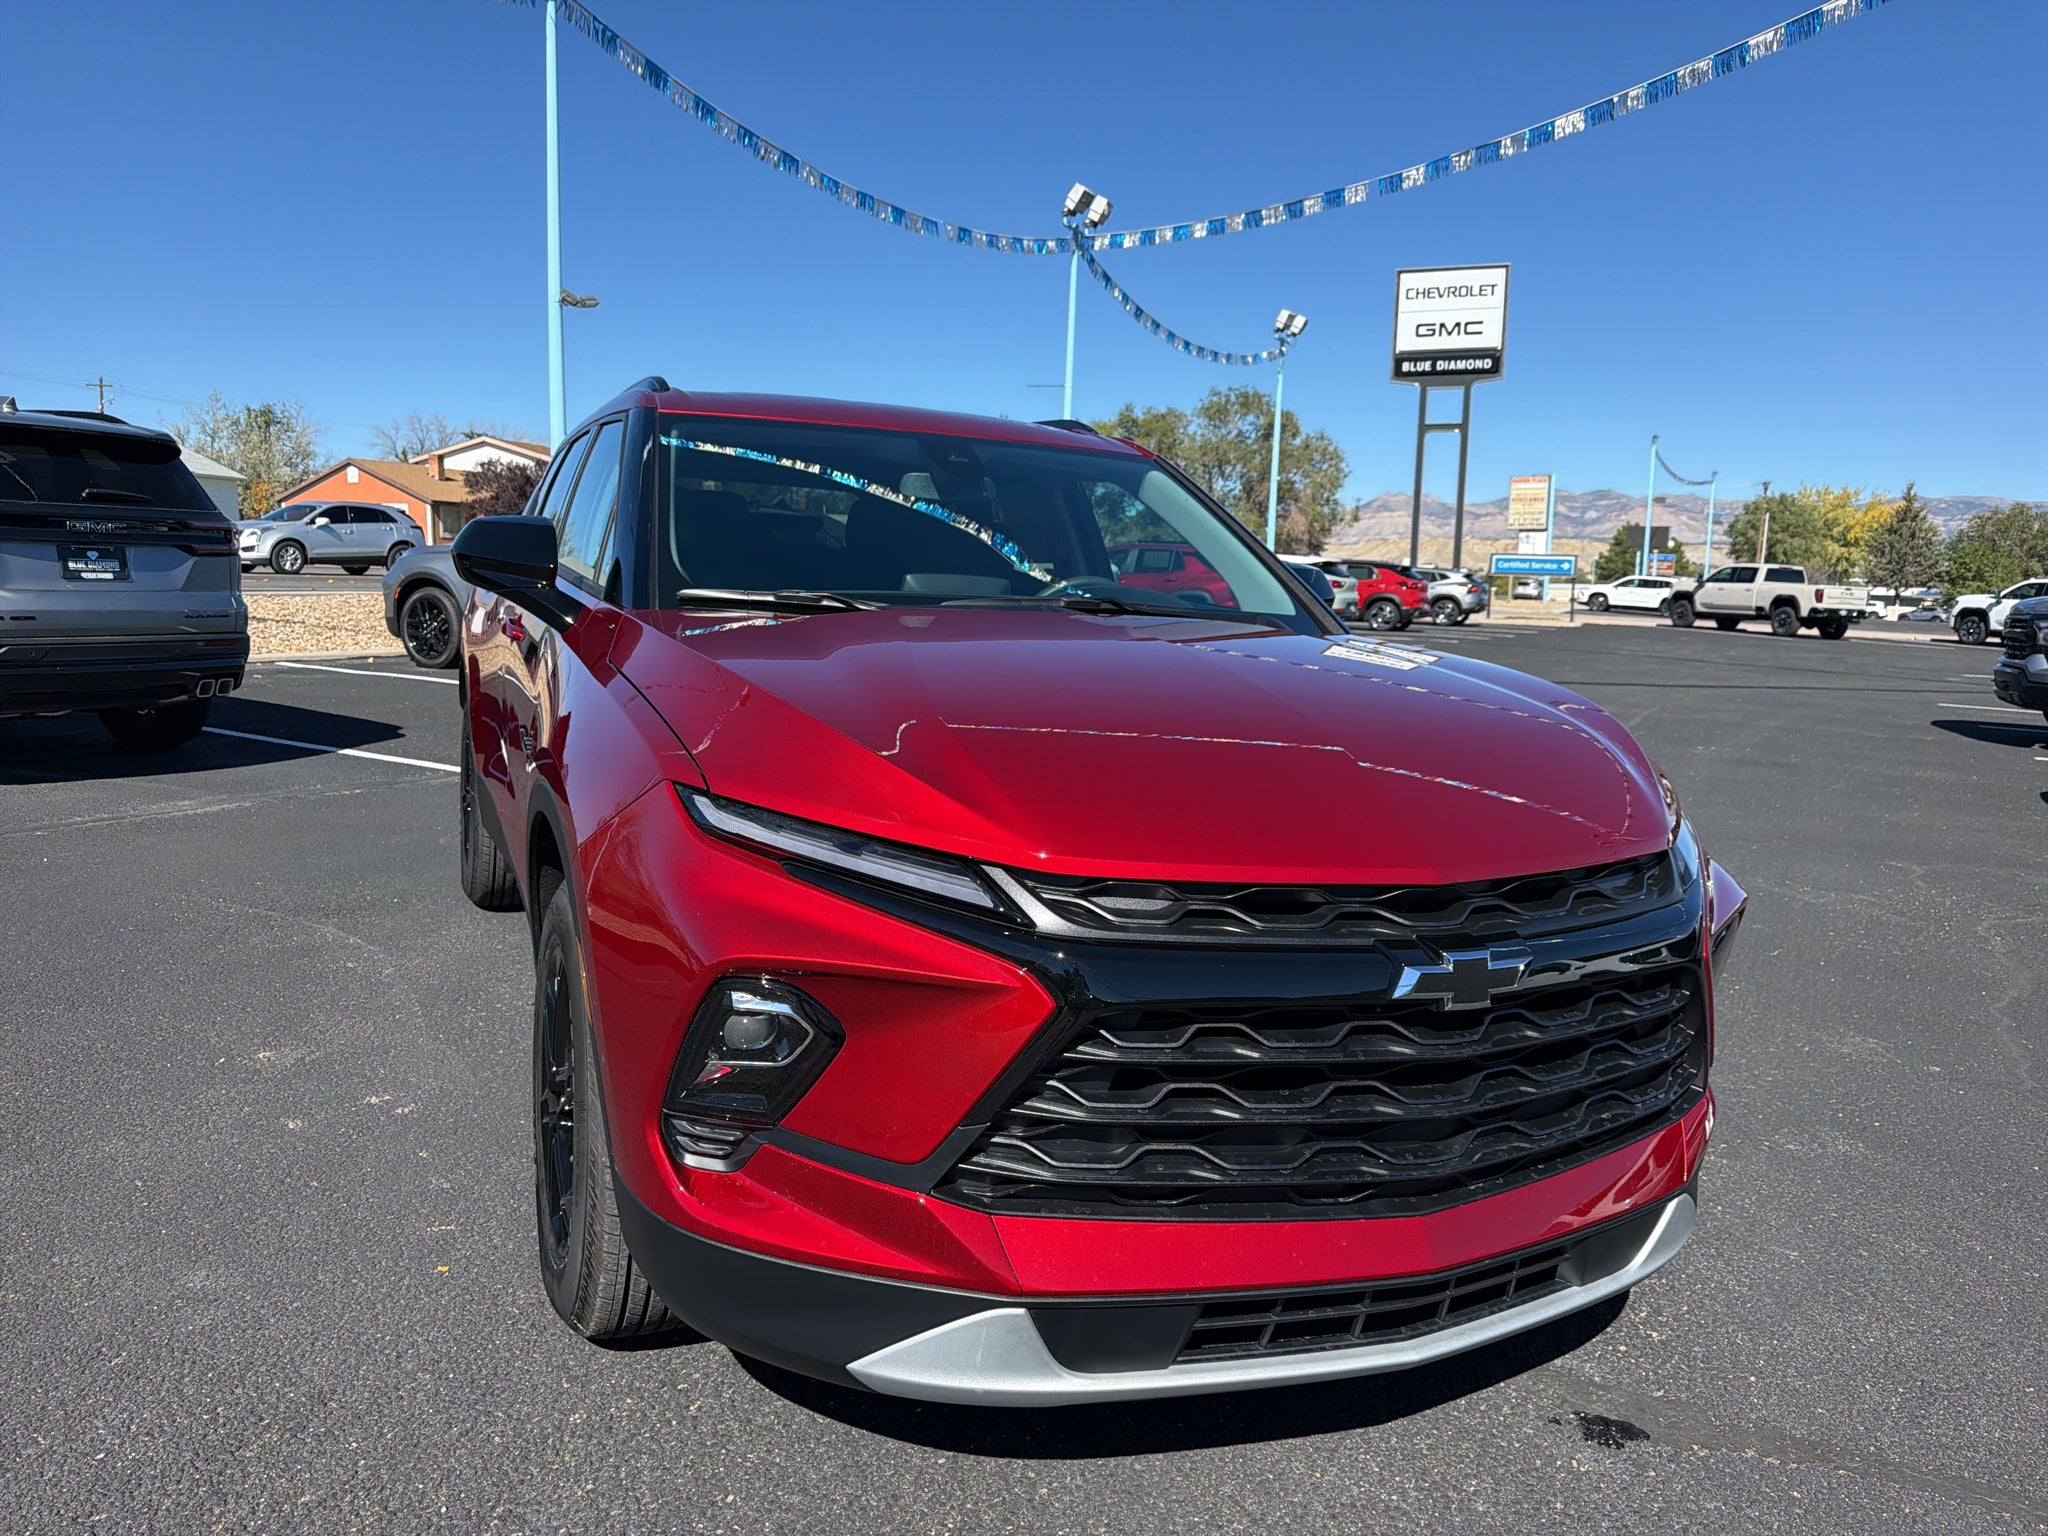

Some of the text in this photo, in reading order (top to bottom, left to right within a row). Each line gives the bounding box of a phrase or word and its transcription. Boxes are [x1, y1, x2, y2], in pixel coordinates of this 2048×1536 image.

[1405, 284, 1498, 300] CHEVROLET
[1415, 321, 1484, 338] GMC
[1402, 359, 1492, 372] BLUE DIAMOND
[66, 521, 127, 534] GMC
[68, 560, 87, 568] BLUE
[1498, 561, 1558, 570] Certified Service
